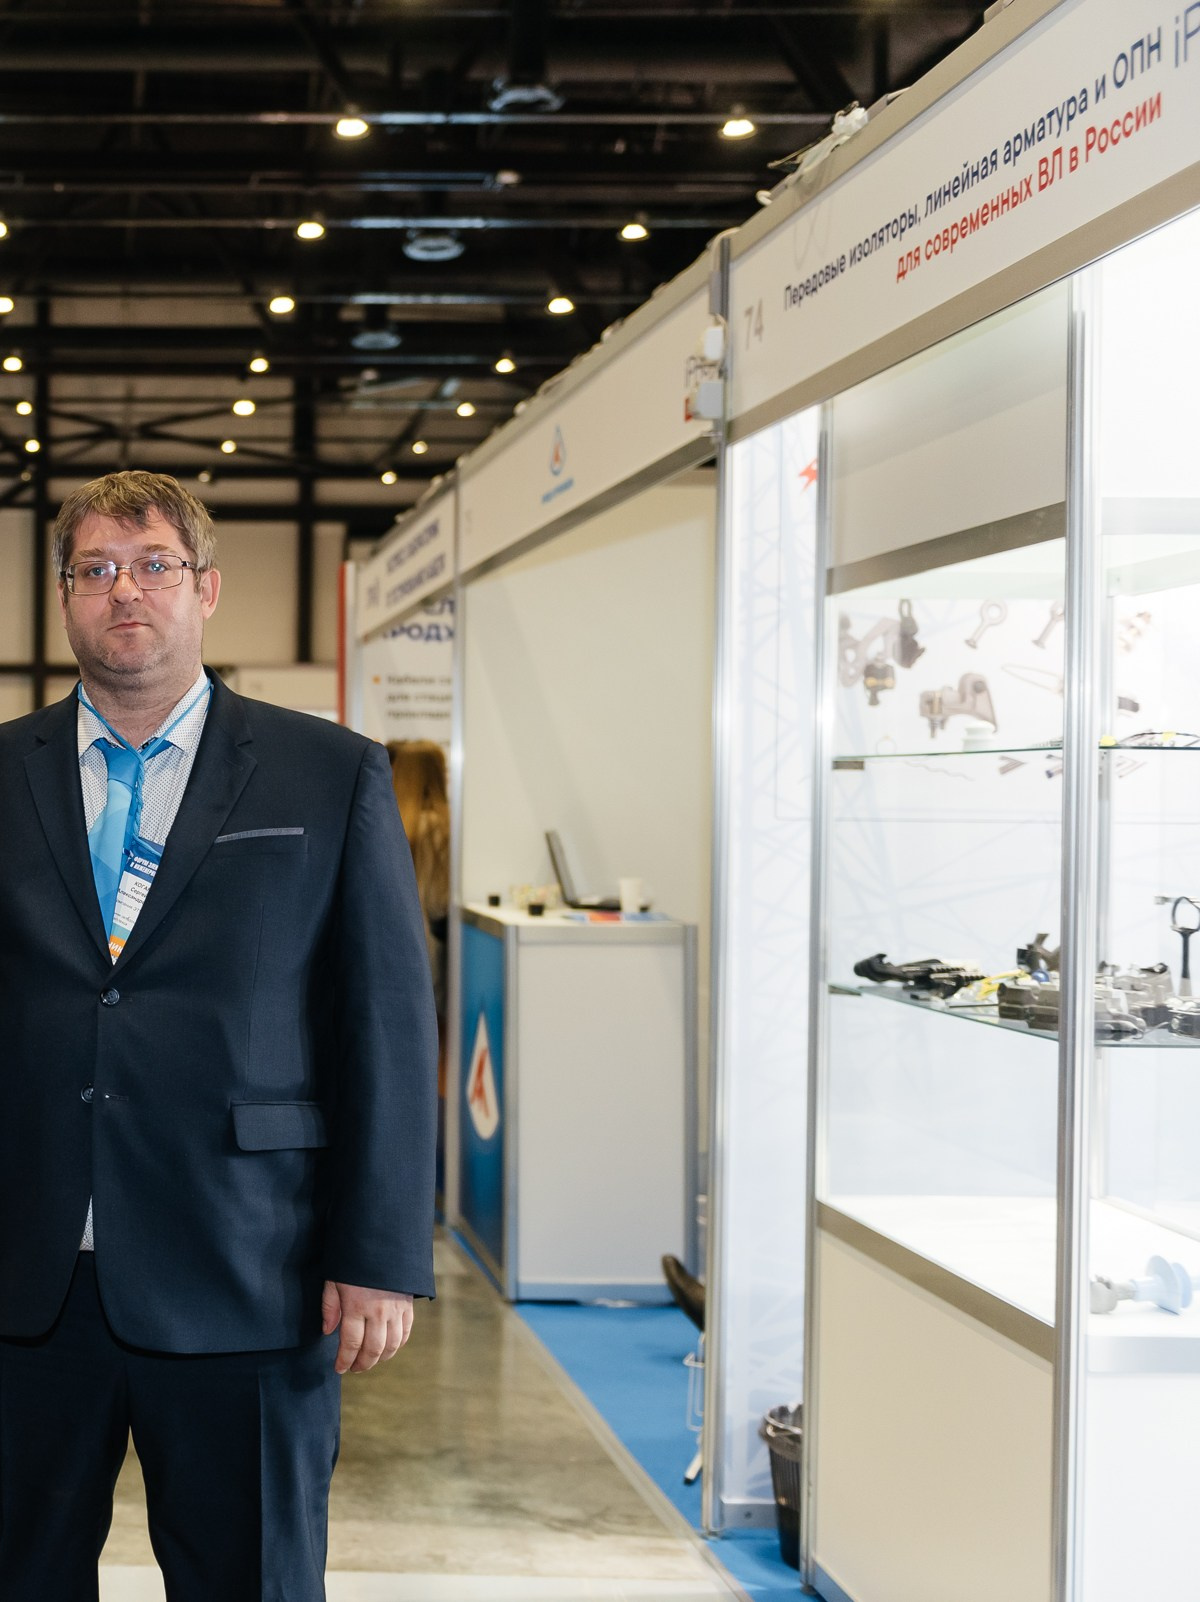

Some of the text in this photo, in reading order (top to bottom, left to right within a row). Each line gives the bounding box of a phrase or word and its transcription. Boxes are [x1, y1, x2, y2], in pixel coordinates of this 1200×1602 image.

[783, 26, 1161, 312] Передовые изоляторы, линейная арматура и ОПН
[896, 91, 1162, 284] для современных ВЛ в России
[744, 298, 764, 351] 74
[134, 881, 151, 891] КОГА
